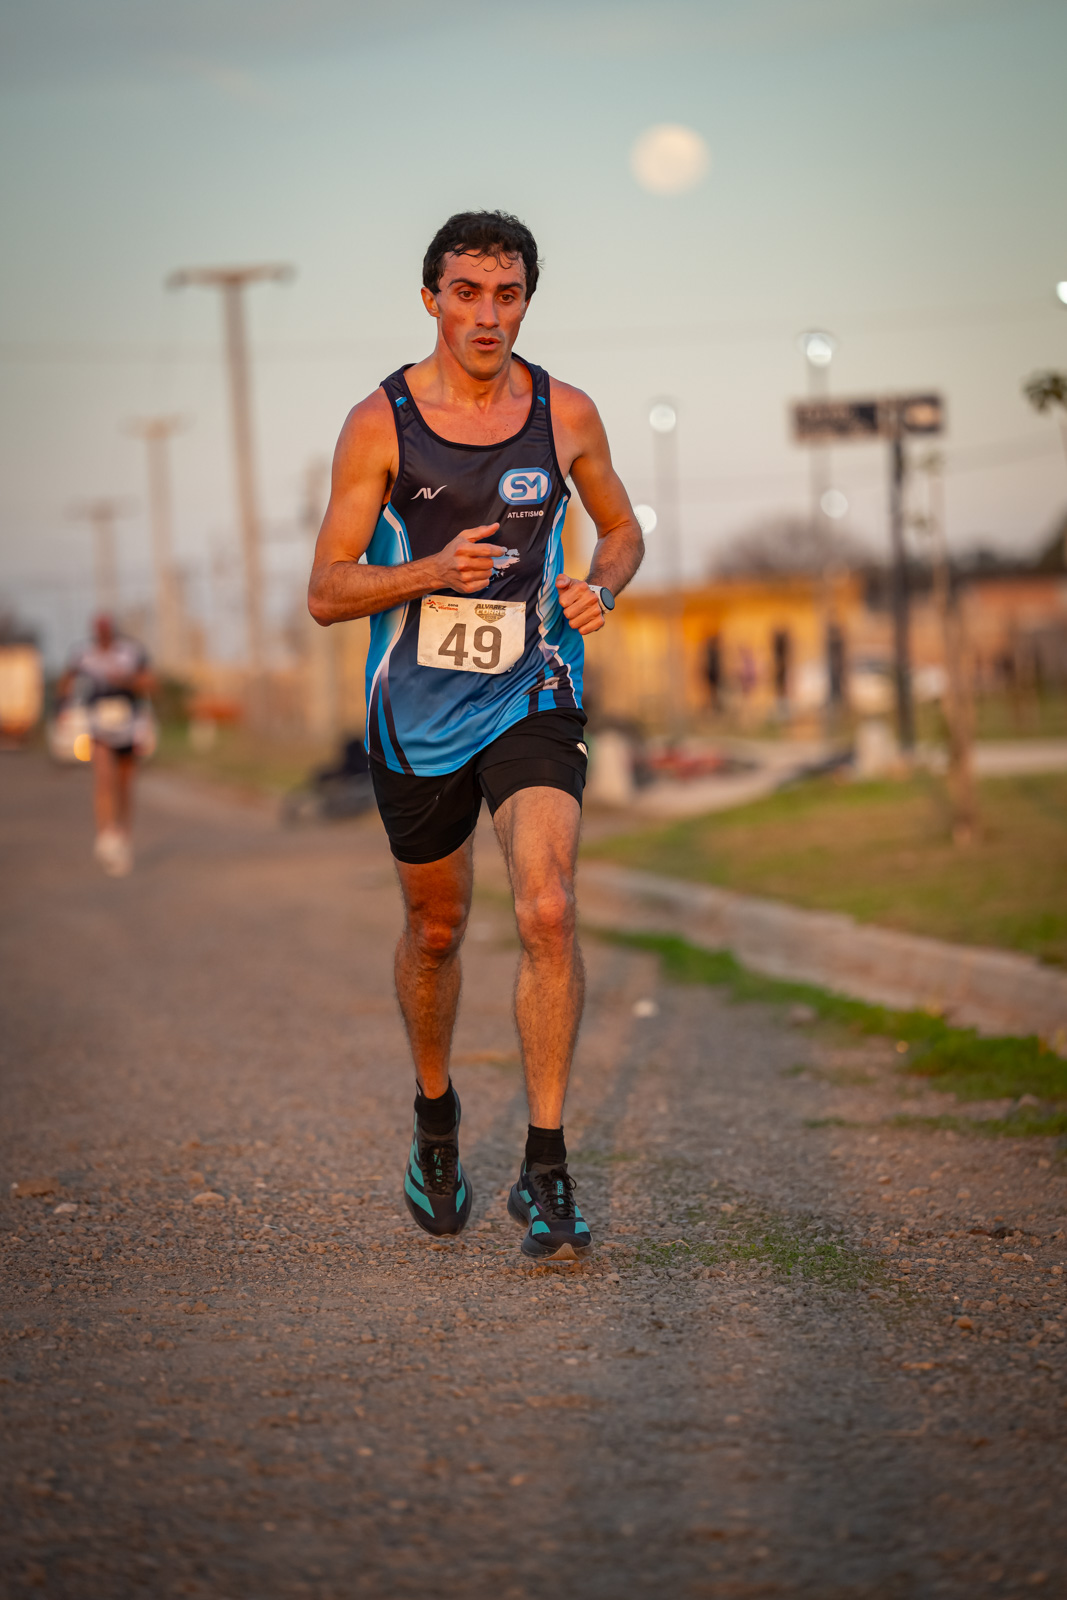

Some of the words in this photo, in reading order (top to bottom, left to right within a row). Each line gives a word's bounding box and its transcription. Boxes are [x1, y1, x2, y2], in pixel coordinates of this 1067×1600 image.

[510, 474, 542, 503] SM
[507, 510, 544, 519] ATLETISMO
[438, 623, 502, 670] 49
